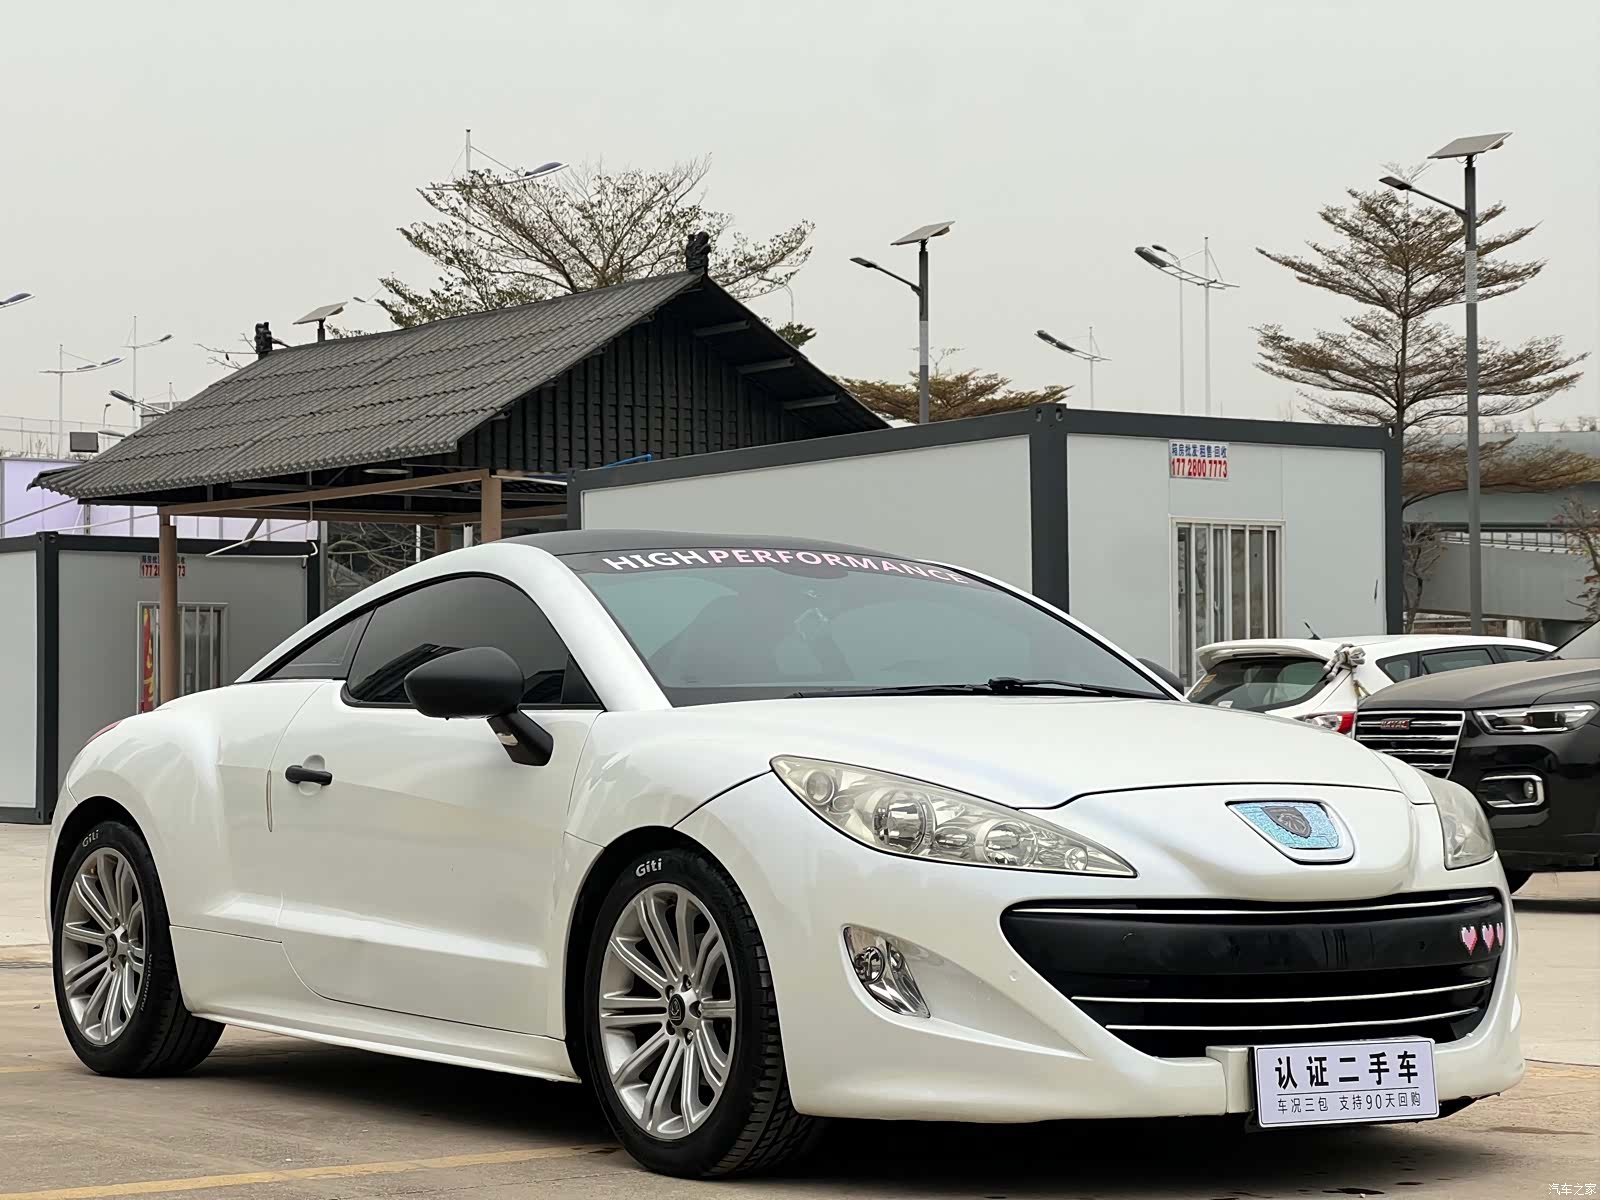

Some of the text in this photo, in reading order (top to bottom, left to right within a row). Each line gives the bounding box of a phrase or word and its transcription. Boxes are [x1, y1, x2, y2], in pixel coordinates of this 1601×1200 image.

[1171, 458, 1228, 478] 177 2800 7773
[141, 564, 153, 577] 177
[602, 548, 970, 585] HIGH PERFORMANCE
[82, 829, 100, 848] Giti
[634, 857, 663, 878] Giti
[1274, 1050, 1419, 1090] 认证二手车
[1277, 1091, 1421, 1114] 车况三包 支持90天回购
